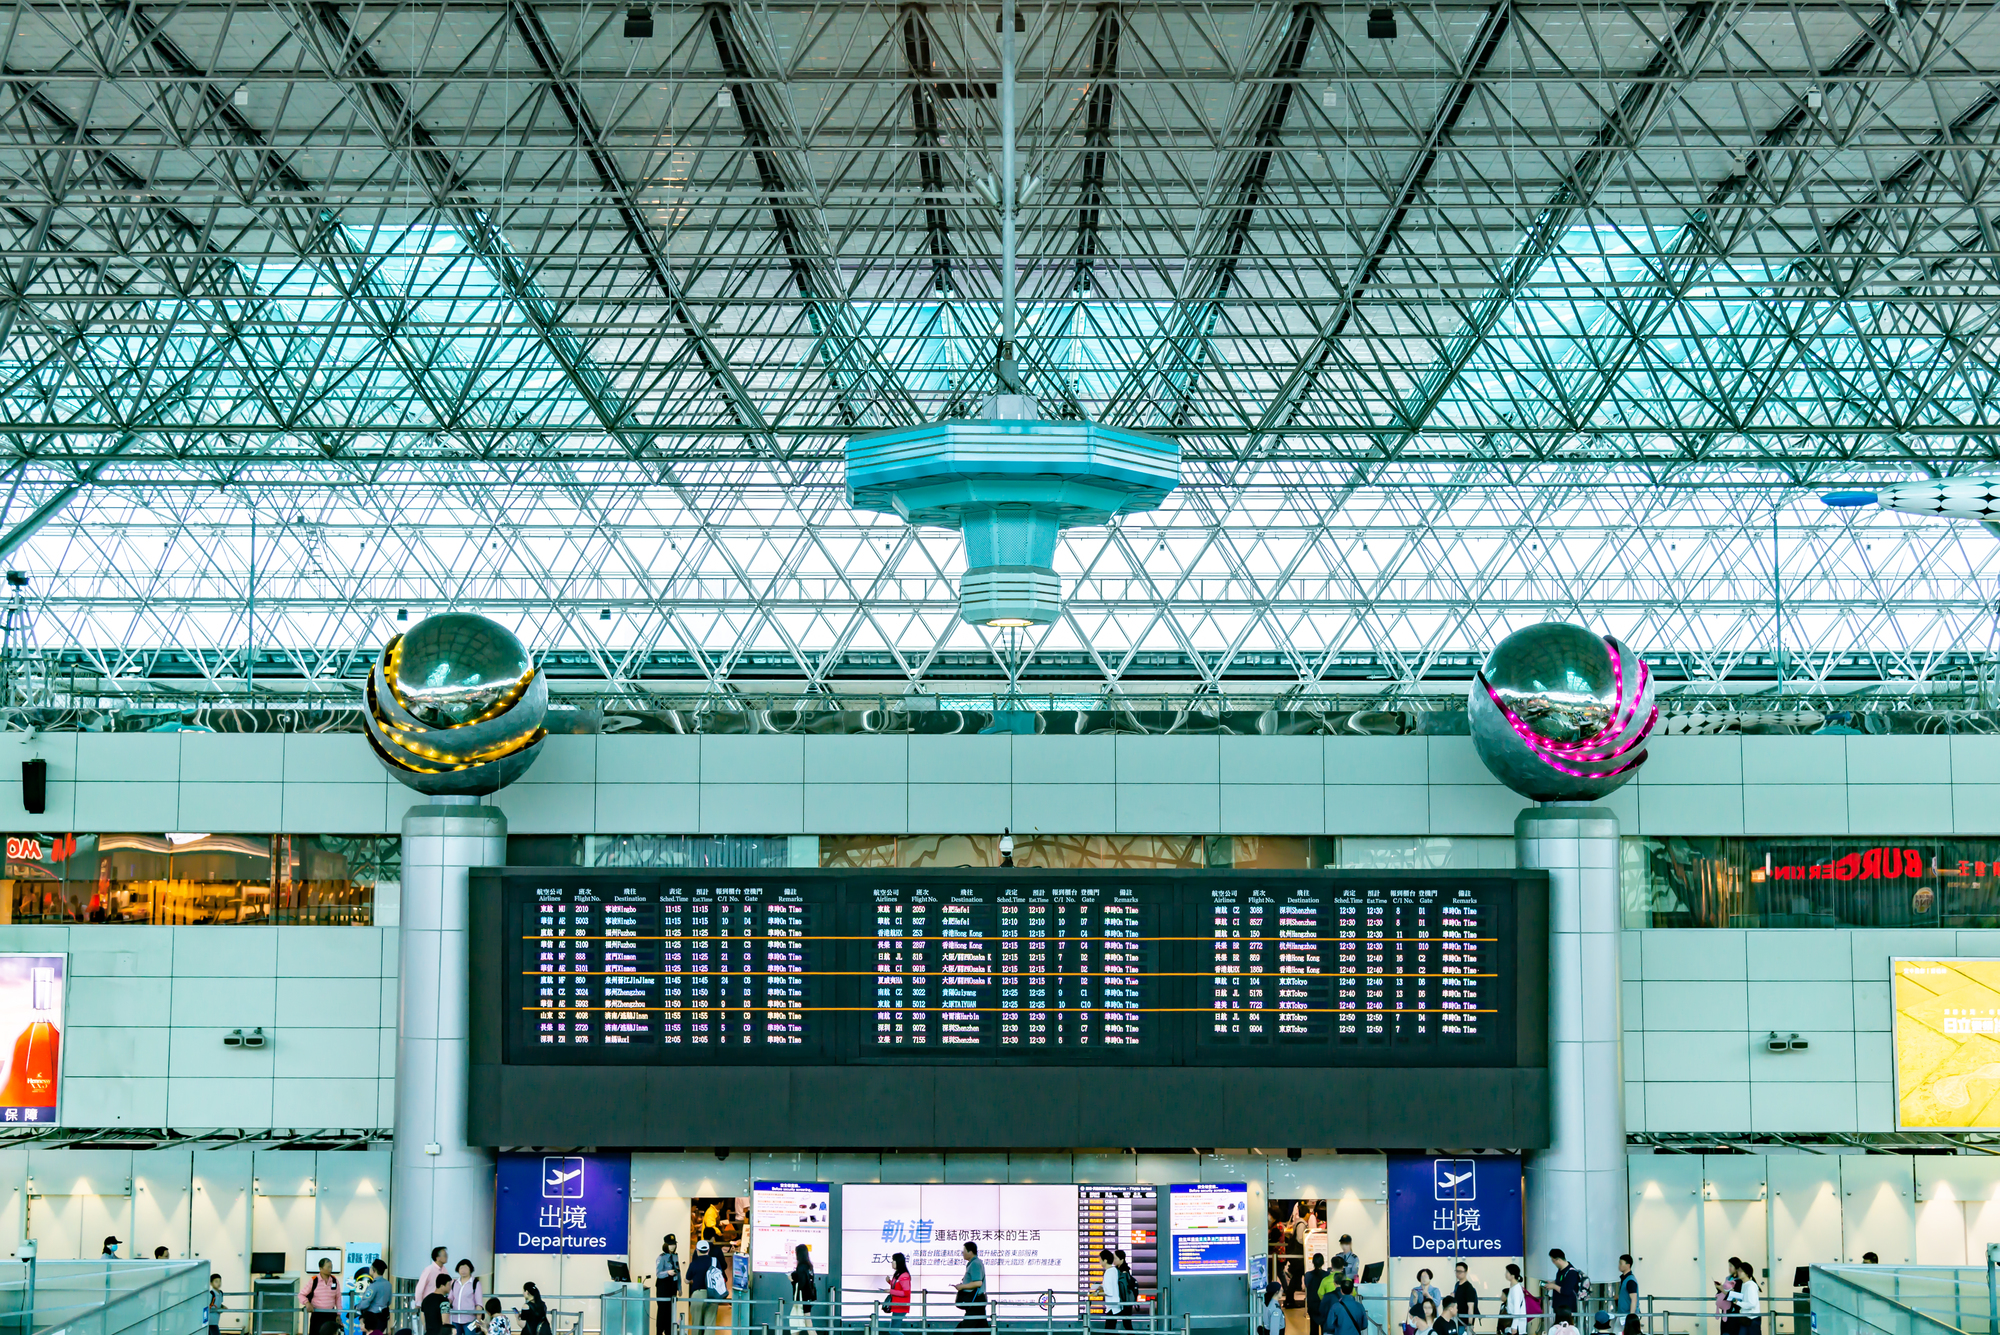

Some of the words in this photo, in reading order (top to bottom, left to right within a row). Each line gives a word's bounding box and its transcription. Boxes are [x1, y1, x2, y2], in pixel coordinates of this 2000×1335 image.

[1248, 897, 1265, 905] Flight
[5, 1108, 38, 1122] 保障
[539, 1205, 587, 1230] 出境
[1433, 1207, 1481, 1232] 出境
[518, 1232, 607, 1249] Departures
[881, 1219, 934, 1244] 軌道
[935, 1229, 1041, 1242] 連結你我未來的生活
[1412, 1235, 1502, 1253] Departures
